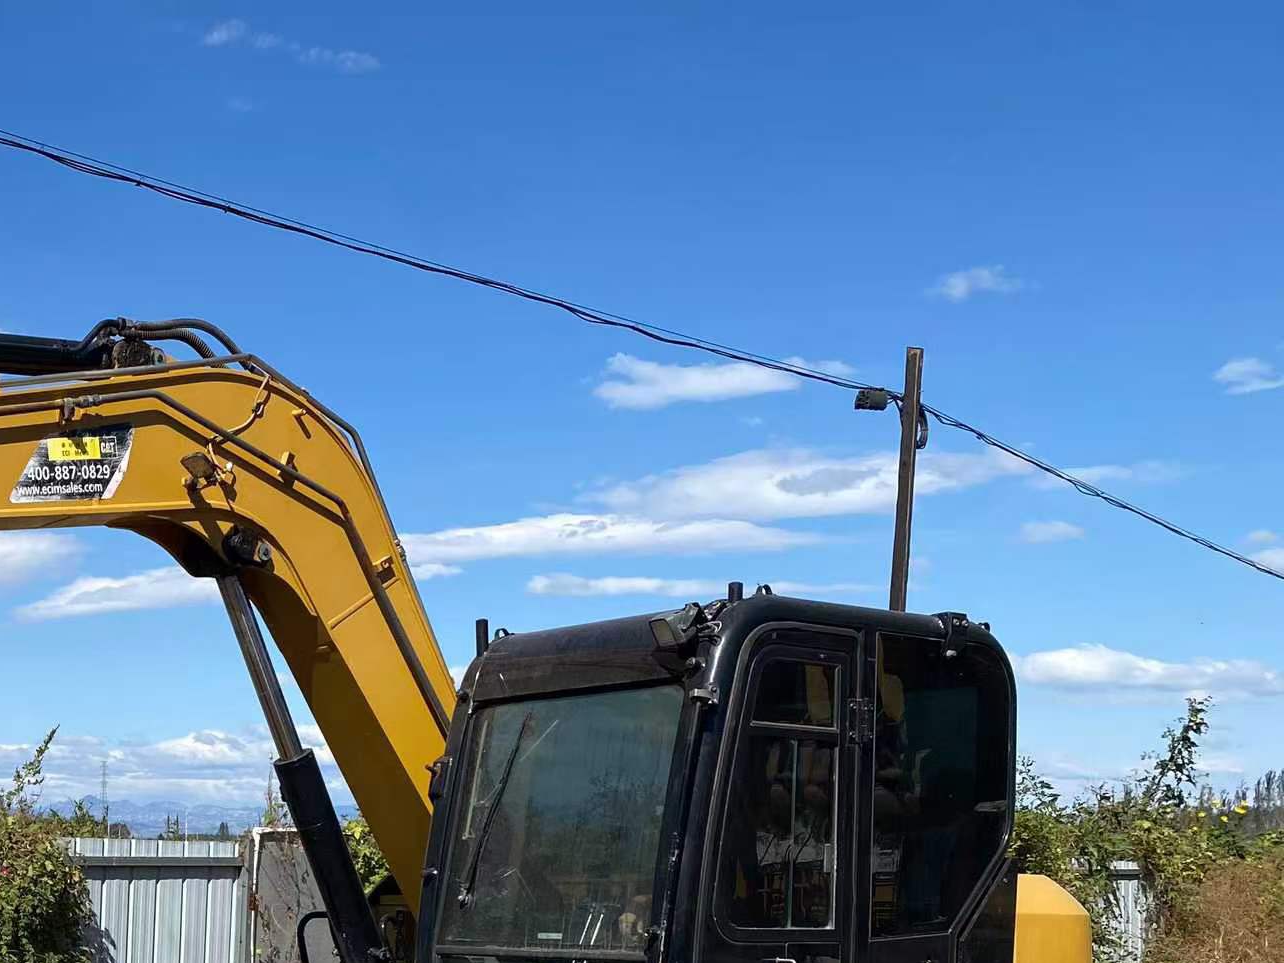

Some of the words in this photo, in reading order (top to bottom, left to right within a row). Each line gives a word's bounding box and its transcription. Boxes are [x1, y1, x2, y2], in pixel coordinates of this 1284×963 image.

[100, 442, 115, 453] CAT
[27, 465, 110, 480] 400-887-0829
[17, 482, 103, 495] www.ecimsales.com
